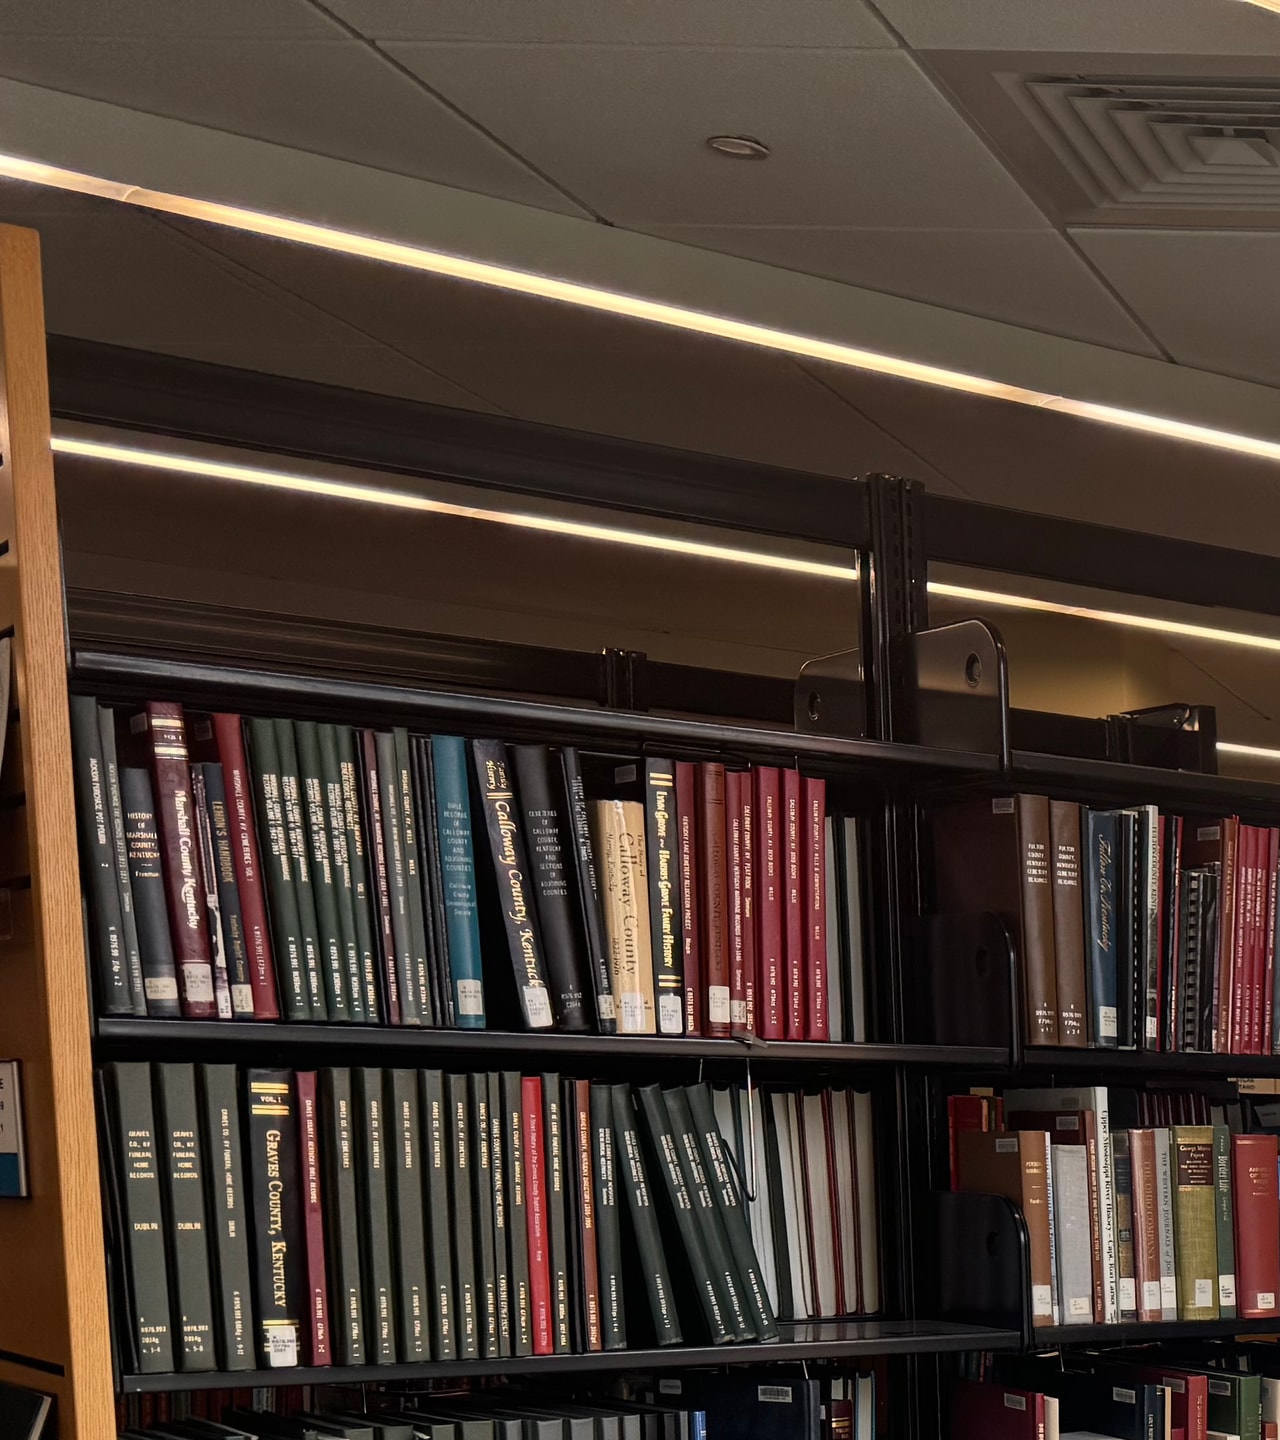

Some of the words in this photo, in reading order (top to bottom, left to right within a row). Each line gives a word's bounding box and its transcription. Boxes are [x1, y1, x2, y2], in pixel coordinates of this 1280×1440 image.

[127, 812, 152, 820] HISTORY
[174, 790, 190, 835] Marshall
[212, 802, 228, 836] LEMON'S
[655, 791, 669, 810] LYNN
[126, 832, 157, 840] MARSHALL
[656, 811, 670, 837] GROVE
[128, 851, 159, 859] KENTUCKY
[179, 837, 193, 876] County
[217, 840, 234, 883] HANDBOOK
[495, 801, 518, 865] Calloway
[508, 869, 529, 925] County,
[618, 832, 638, 907] Calloway
[1098, 834, 1112, 877] Fulton
[180, 878, 199, 929] Kentucky
[658, 881, 672, 906] GROVE
[1100, 878, 1111, 893] Co.
[1097, 895, 1113, 952] Kentucky
[623, 915, 639, 976] County
[662, 934, 674, 968] HISTORY
[265, 1130, 281, 1178] GRAVES
[1102, 1137, 1110, 1178] Mississippi
[1217, 1155, 1228, 1177] Border
[1218, 1179, 1229, 1192] Life
[134, 1222, 158, 1230] DUBLIN
[179, 1222, 202, 1230] DUBLIN
[267, 1180, 282, 1236] COUNTY,
[1104, 1203, 1113, 1231] History
[1146, 1211, 1155, 1260] COMPANY
[1163, 1209, 1171, 1247] JOURNALS
[271, 1241, 287, 1308] KENTUCKY
